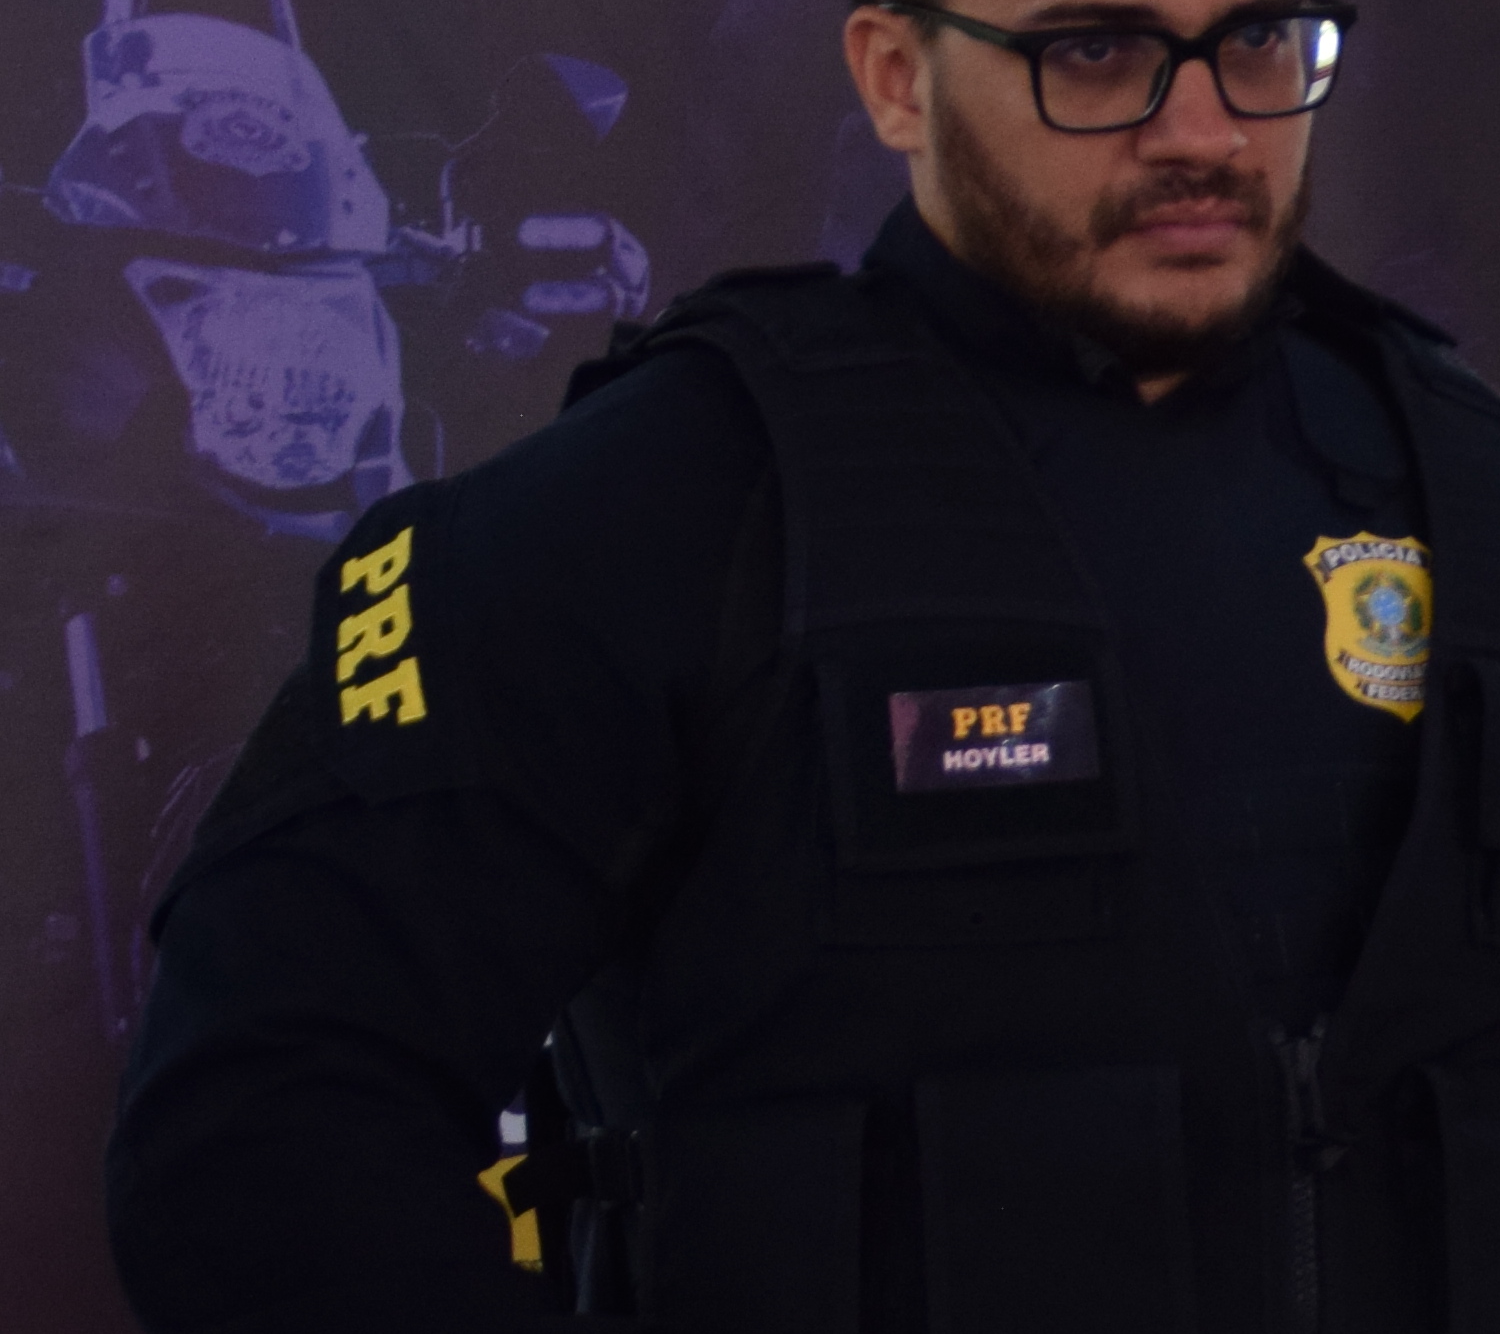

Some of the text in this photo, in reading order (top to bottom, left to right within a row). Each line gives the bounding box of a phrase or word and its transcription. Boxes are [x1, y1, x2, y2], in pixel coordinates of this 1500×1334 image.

[337, 525, 428, 725] PRF
[952, 702, 1032, 740] PRF
[943, 743, 1051, 772] HOYLER
